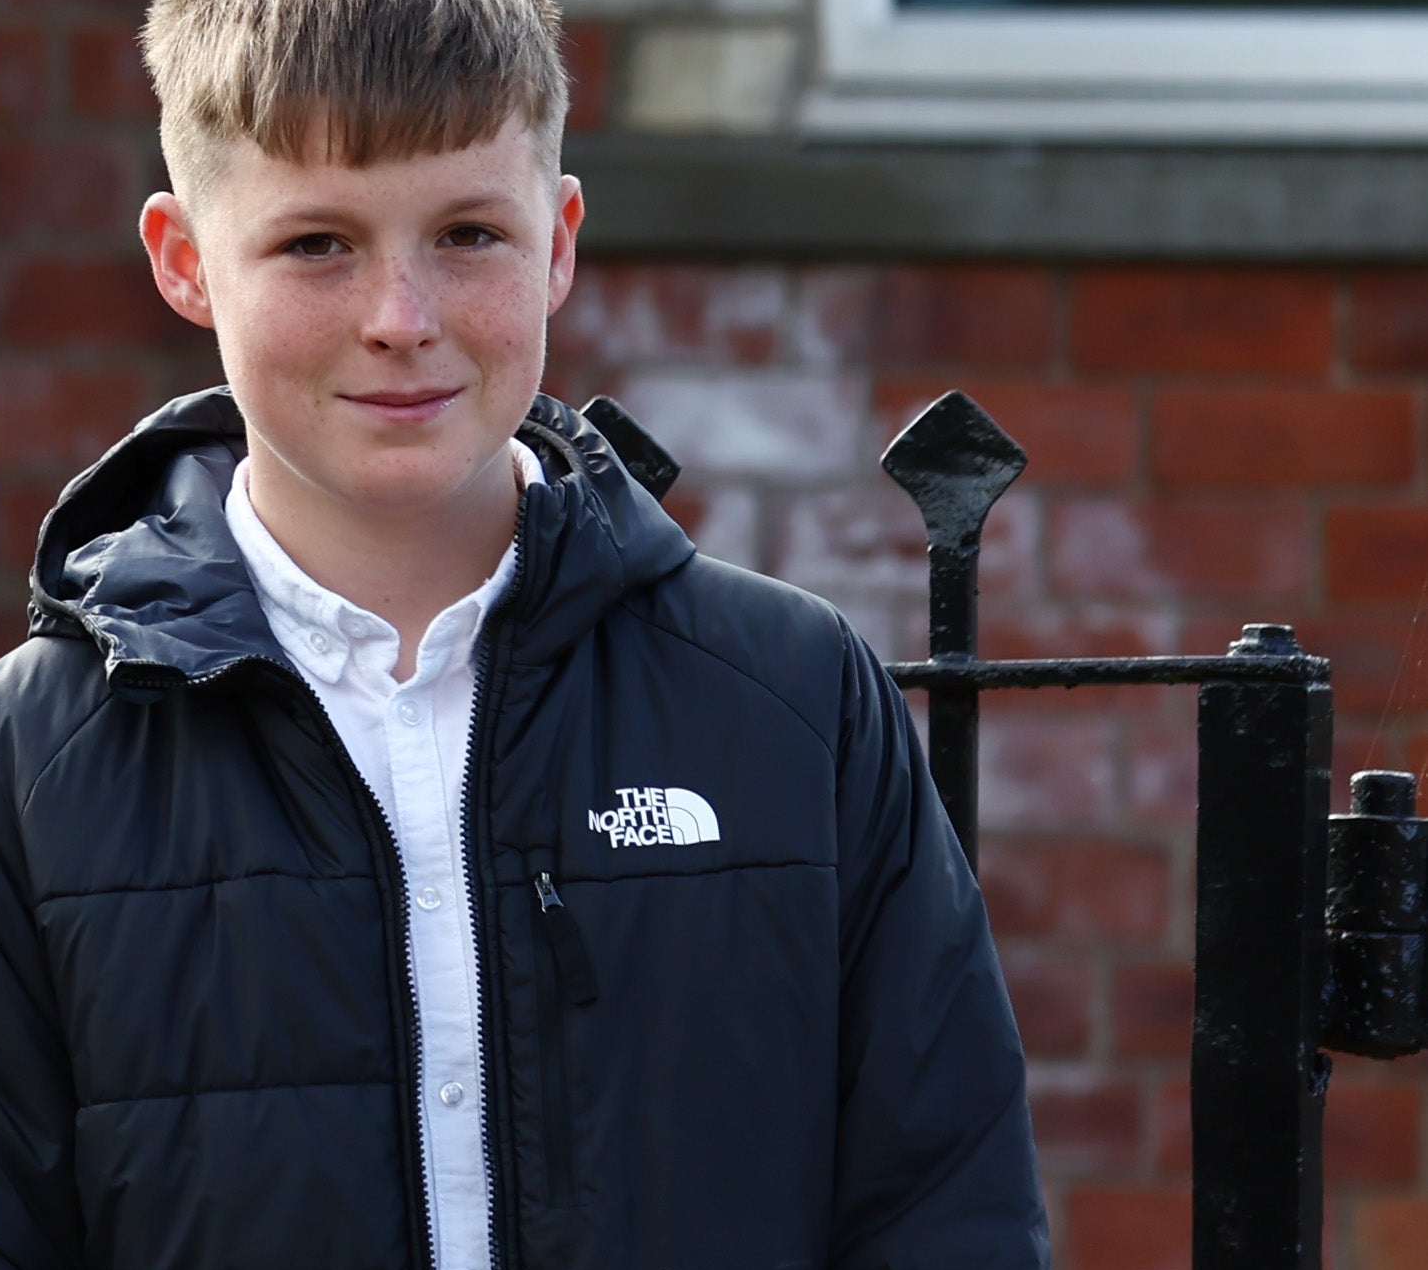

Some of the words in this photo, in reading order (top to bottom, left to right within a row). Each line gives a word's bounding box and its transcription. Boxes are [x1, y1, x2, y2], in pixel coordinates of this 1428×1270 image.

[615, 787, 667, 808] THE
[588, 805, 670, 833] NORTH
[609, 824, 674, 848] FACE
